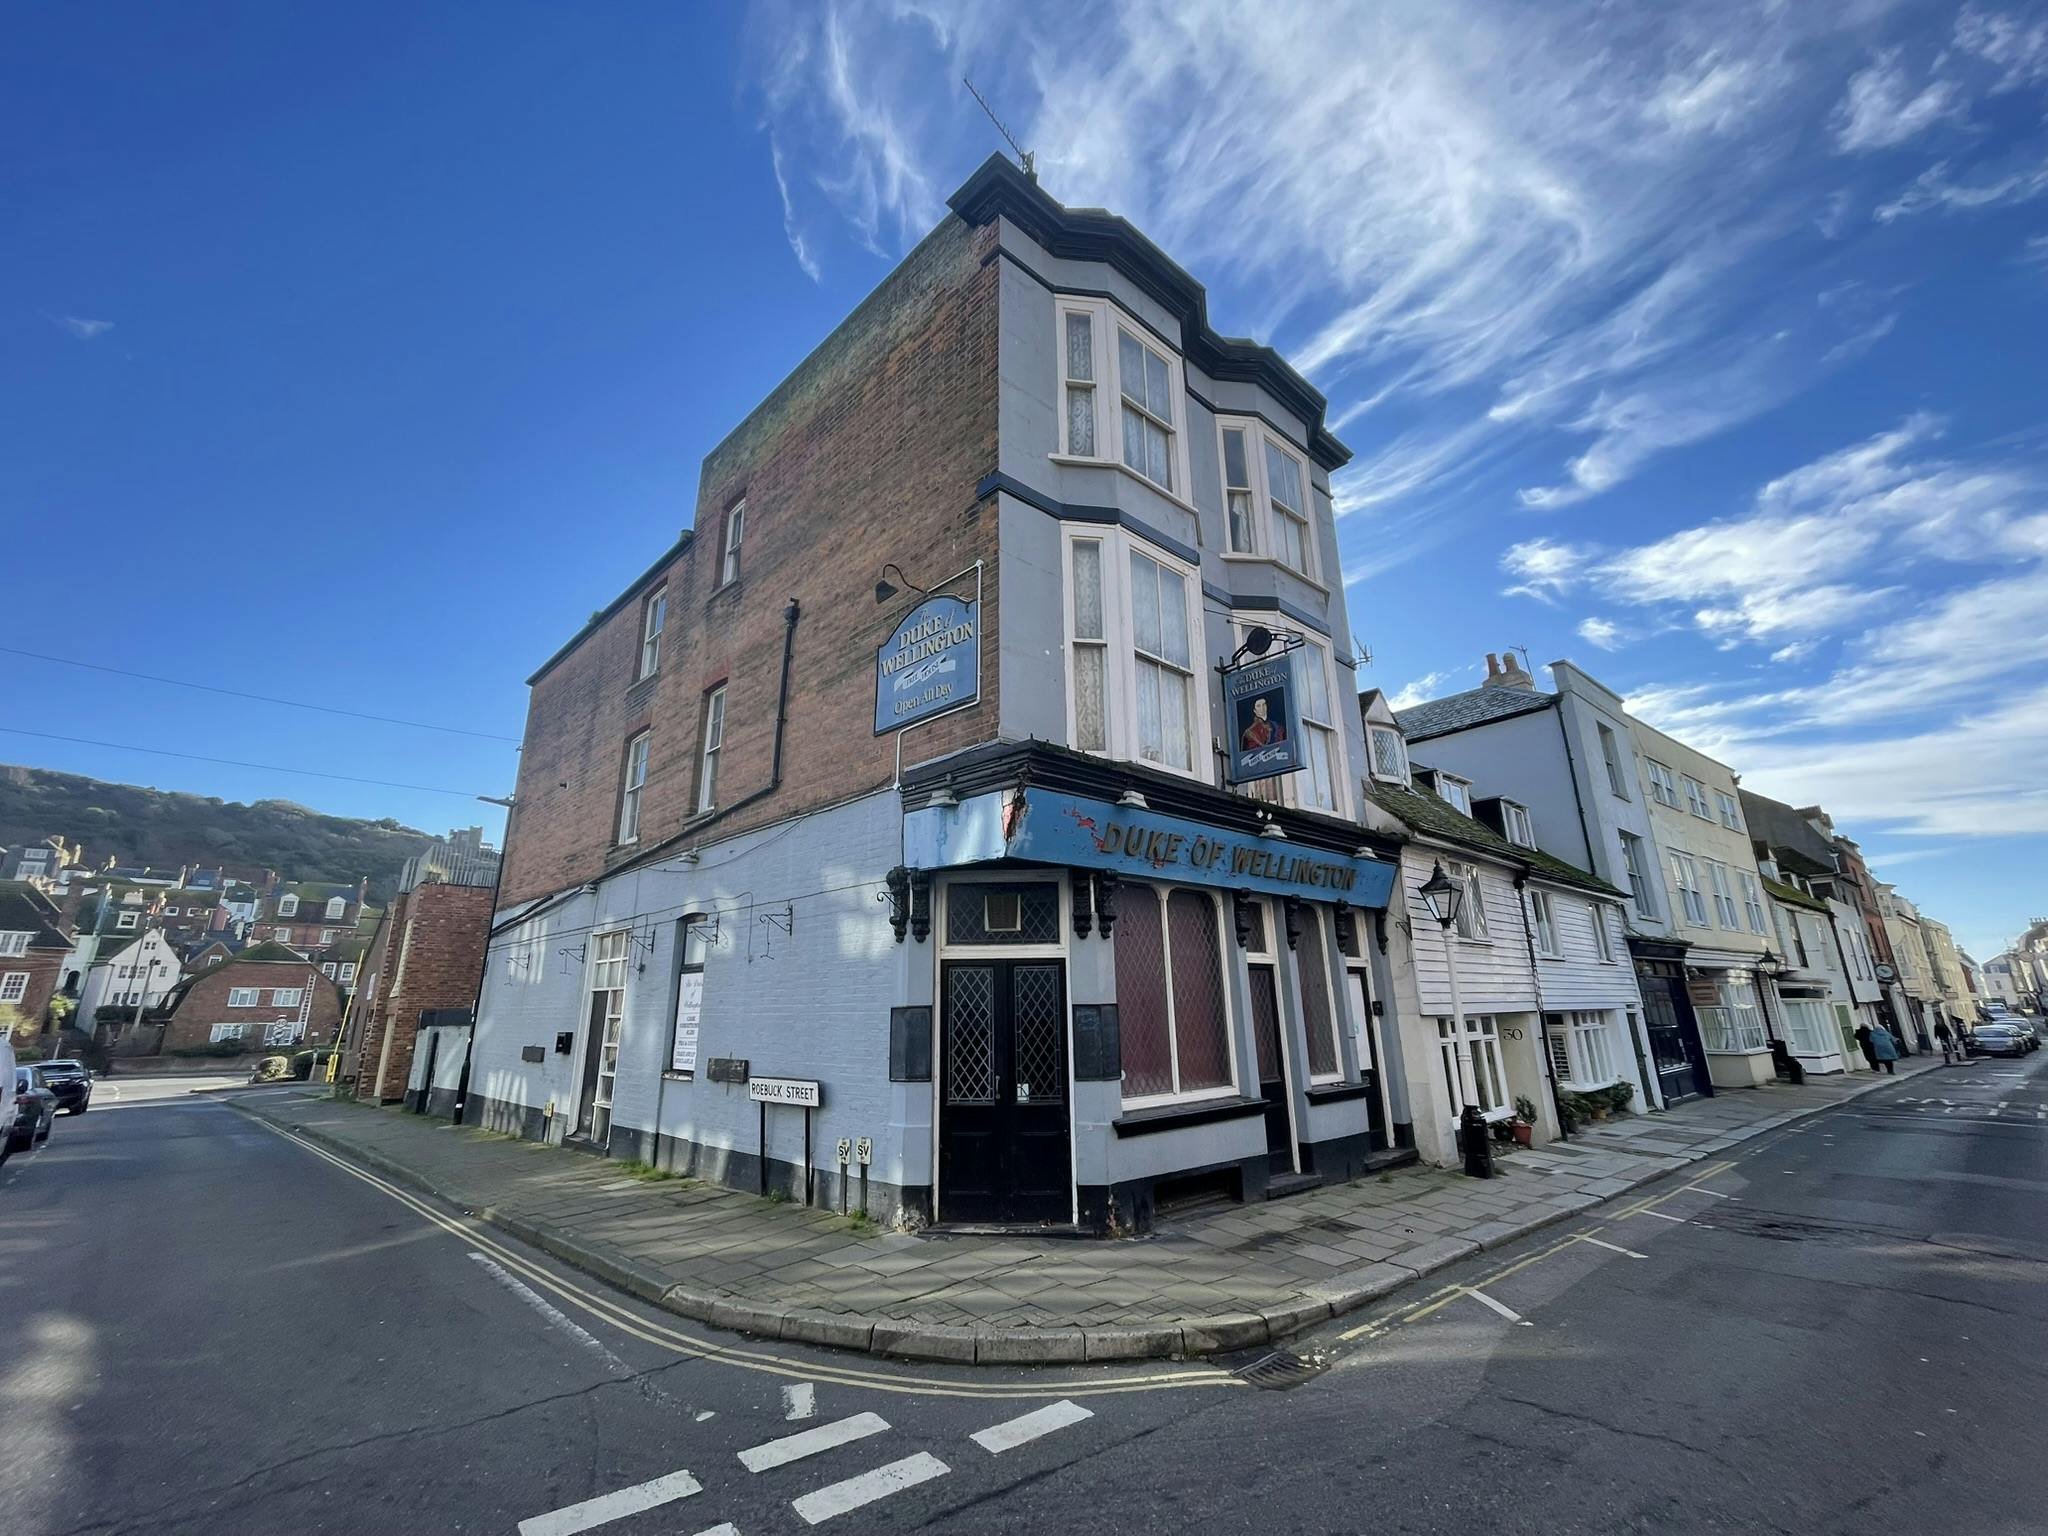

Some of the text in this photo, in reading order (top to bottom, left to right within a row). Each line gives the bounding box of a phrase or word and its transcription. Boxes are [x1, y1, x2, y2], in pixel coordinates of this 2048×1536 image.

[898, 615, 943, 652] DUKE
[881, 620, 974, 678] WELLINGTON
[1231, 672, 1288, 697] WELLINGTON
[1245, 667, 1271, 682] DUKE
[894, 683, 952, 716] Open All Day
[1100, 822, 1357, 891] DUKE OF WELLINGTON
[752, 1083, 814, 1100] ROEBUCK STREET
[839, 1146, 850, 1157] SV
[858, 1145, 869, 1156] SV
